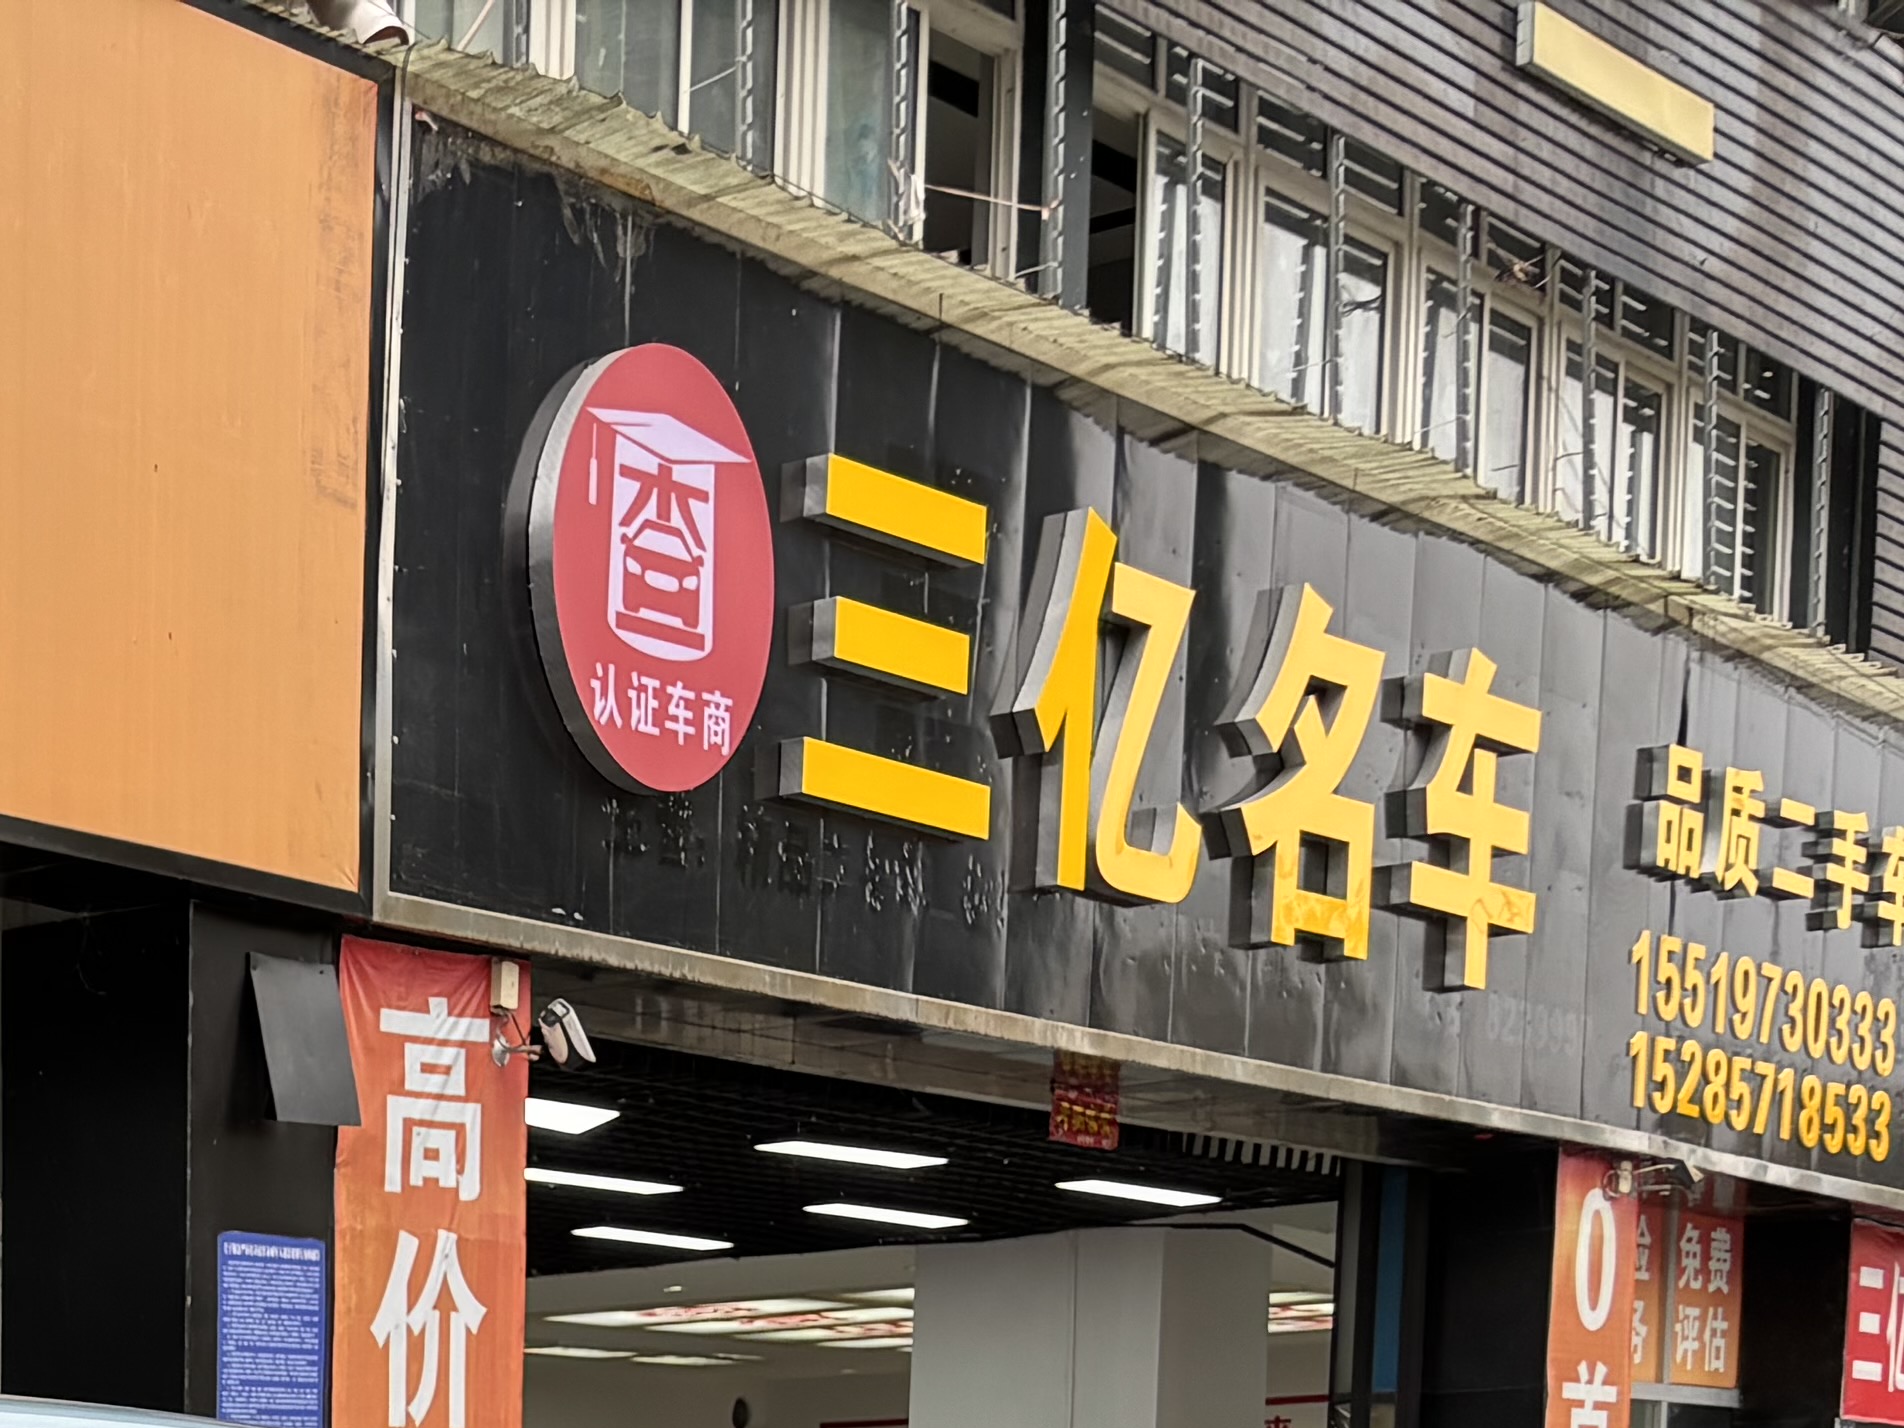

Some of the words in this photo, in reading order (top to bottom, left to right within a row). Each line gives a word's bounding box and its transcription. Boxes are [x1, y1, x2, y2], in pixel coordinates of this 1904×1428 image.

[590, 661, 734, 757] 认证车商
[799, 452, 1542, 990] 三亿名车
[1630, 930, 1897, 1078] 15519730333
[1629, 1030, 1892, 1162] 15285718533
[1678, 1222, 1732, 1295] 免费
[1674, 1304, 1729, 1373] 评估
